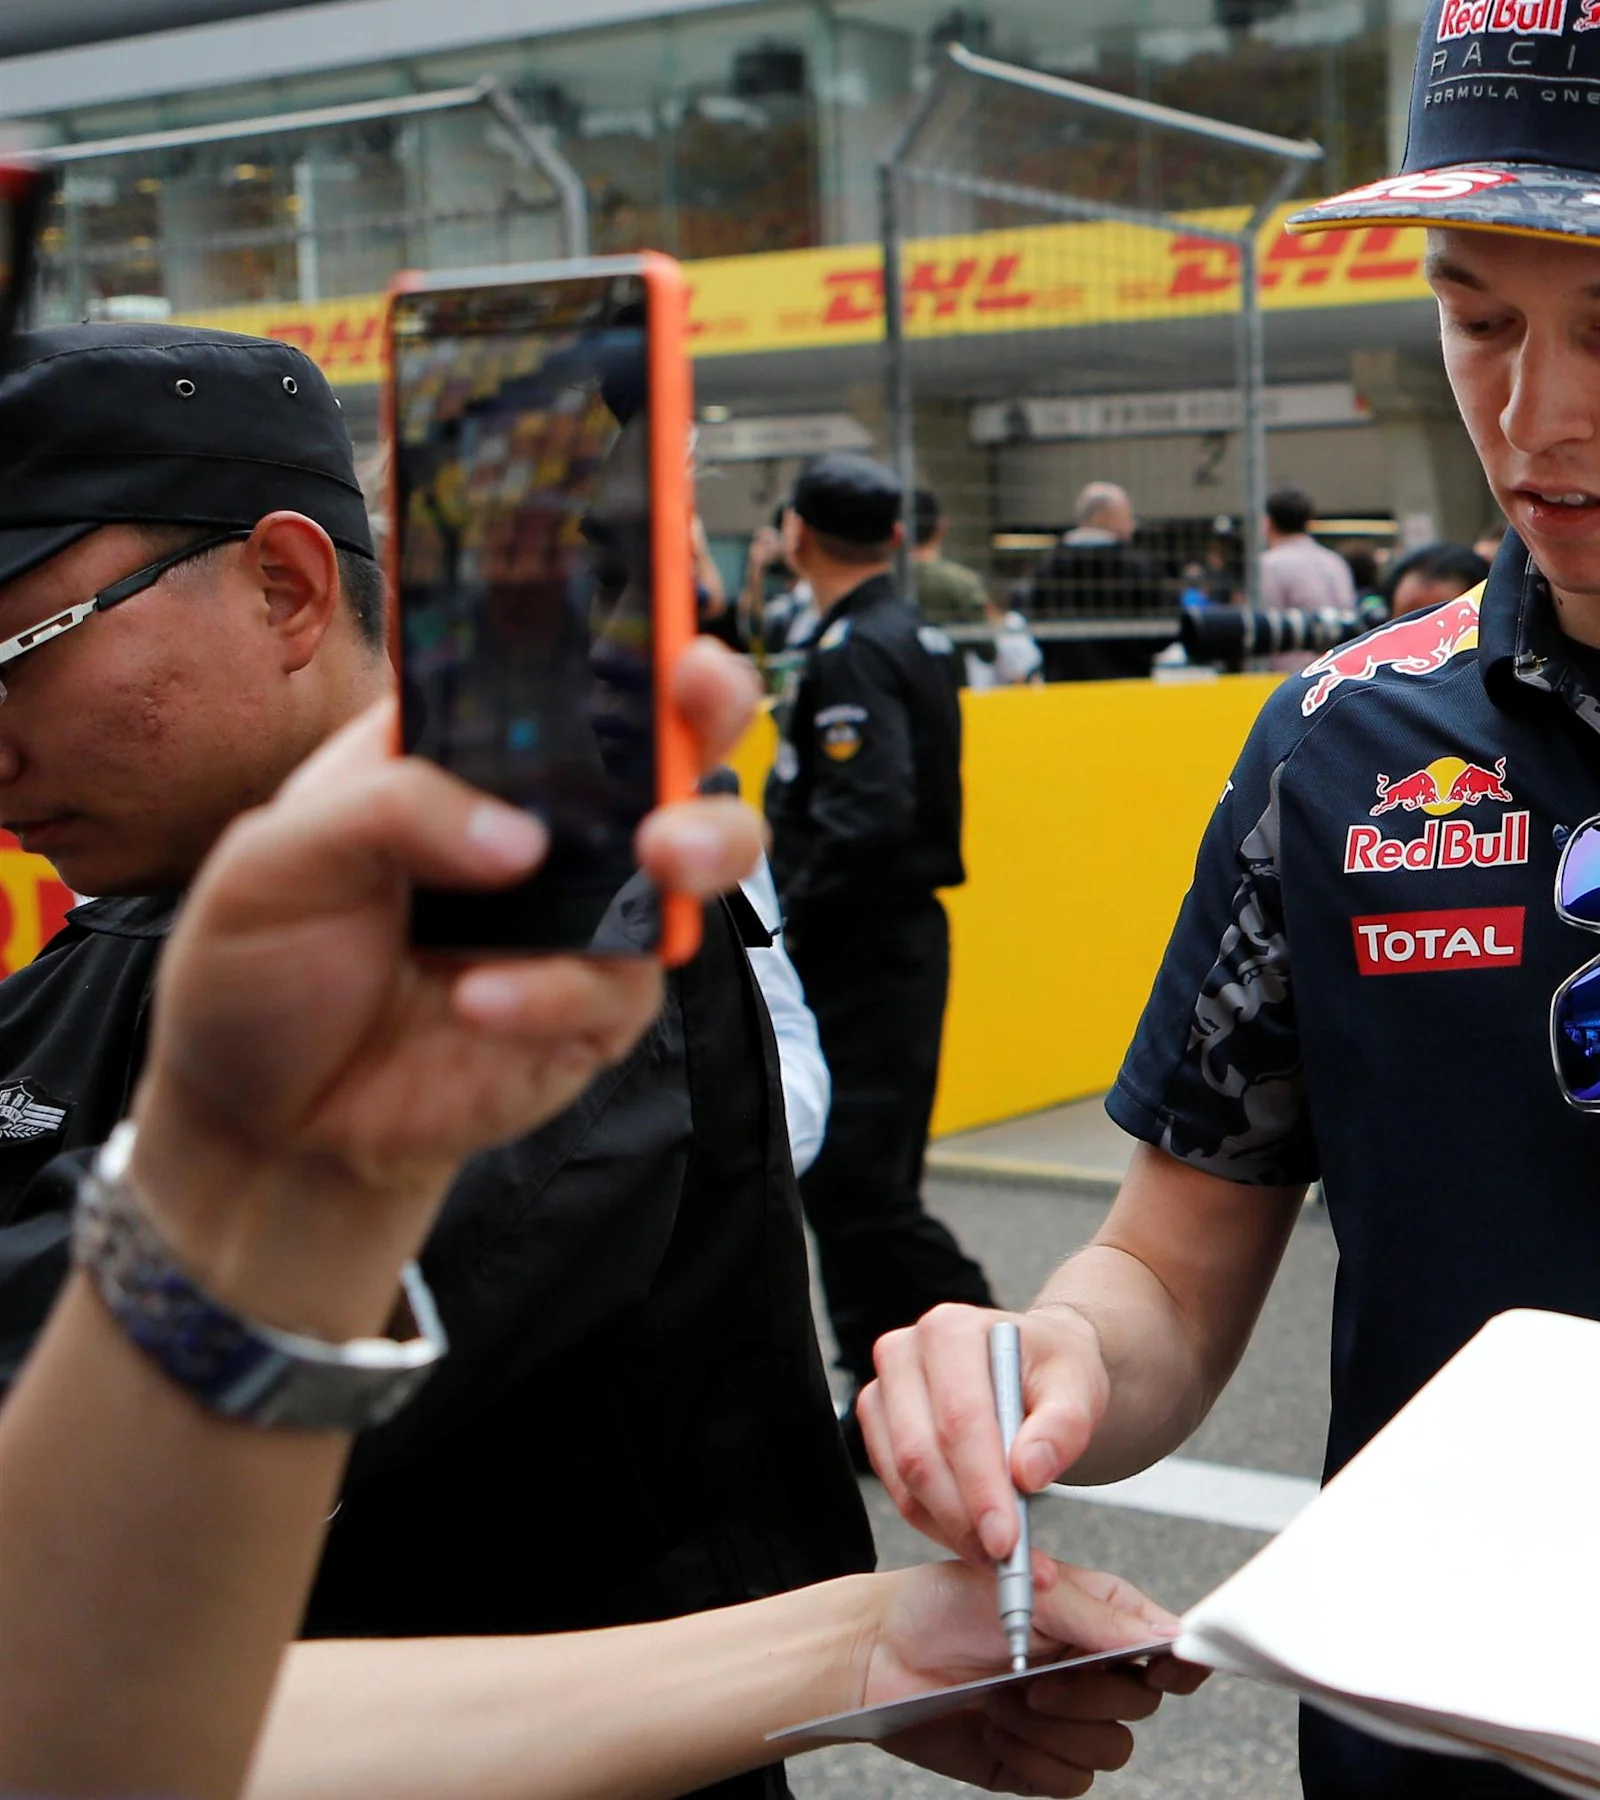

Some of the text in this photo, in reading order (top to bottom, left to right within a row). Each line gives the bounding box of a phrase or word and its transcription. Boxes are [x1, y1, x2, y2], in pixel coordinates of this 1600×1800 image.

[1438, 0, 1568, 42] Red Bull
[1424, 83, 1519, 109] FORMULA
[1541, 89, 1600, 105] ONE
[1166, 226, 1420, 299] DHL
[822, 253, 1033, 325] DHL
[1345, 811, 1529, 873] Red Bull
[1358, 923, 1514, 963] TOTAL
